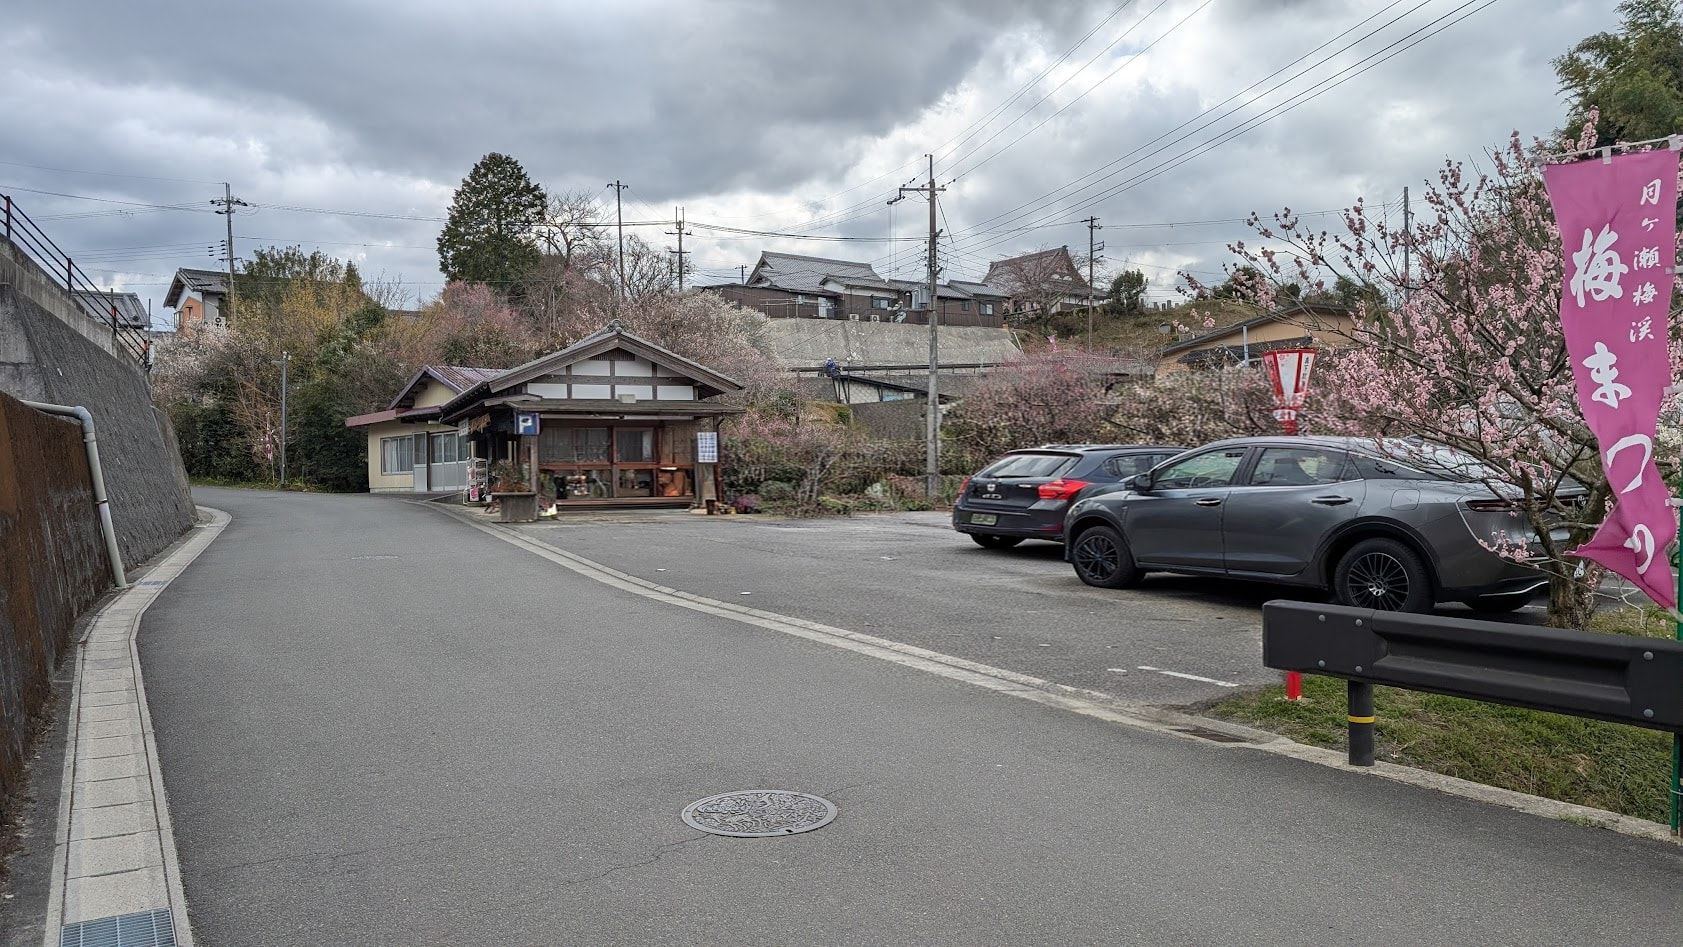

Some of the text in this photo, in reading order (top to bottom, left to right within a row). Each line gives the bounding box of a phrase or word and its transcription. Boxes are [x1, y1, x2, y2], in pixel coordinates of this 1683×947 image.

[518, 415, 533, 434] P
[1569, 223, 1655, 576] 梅まつり
